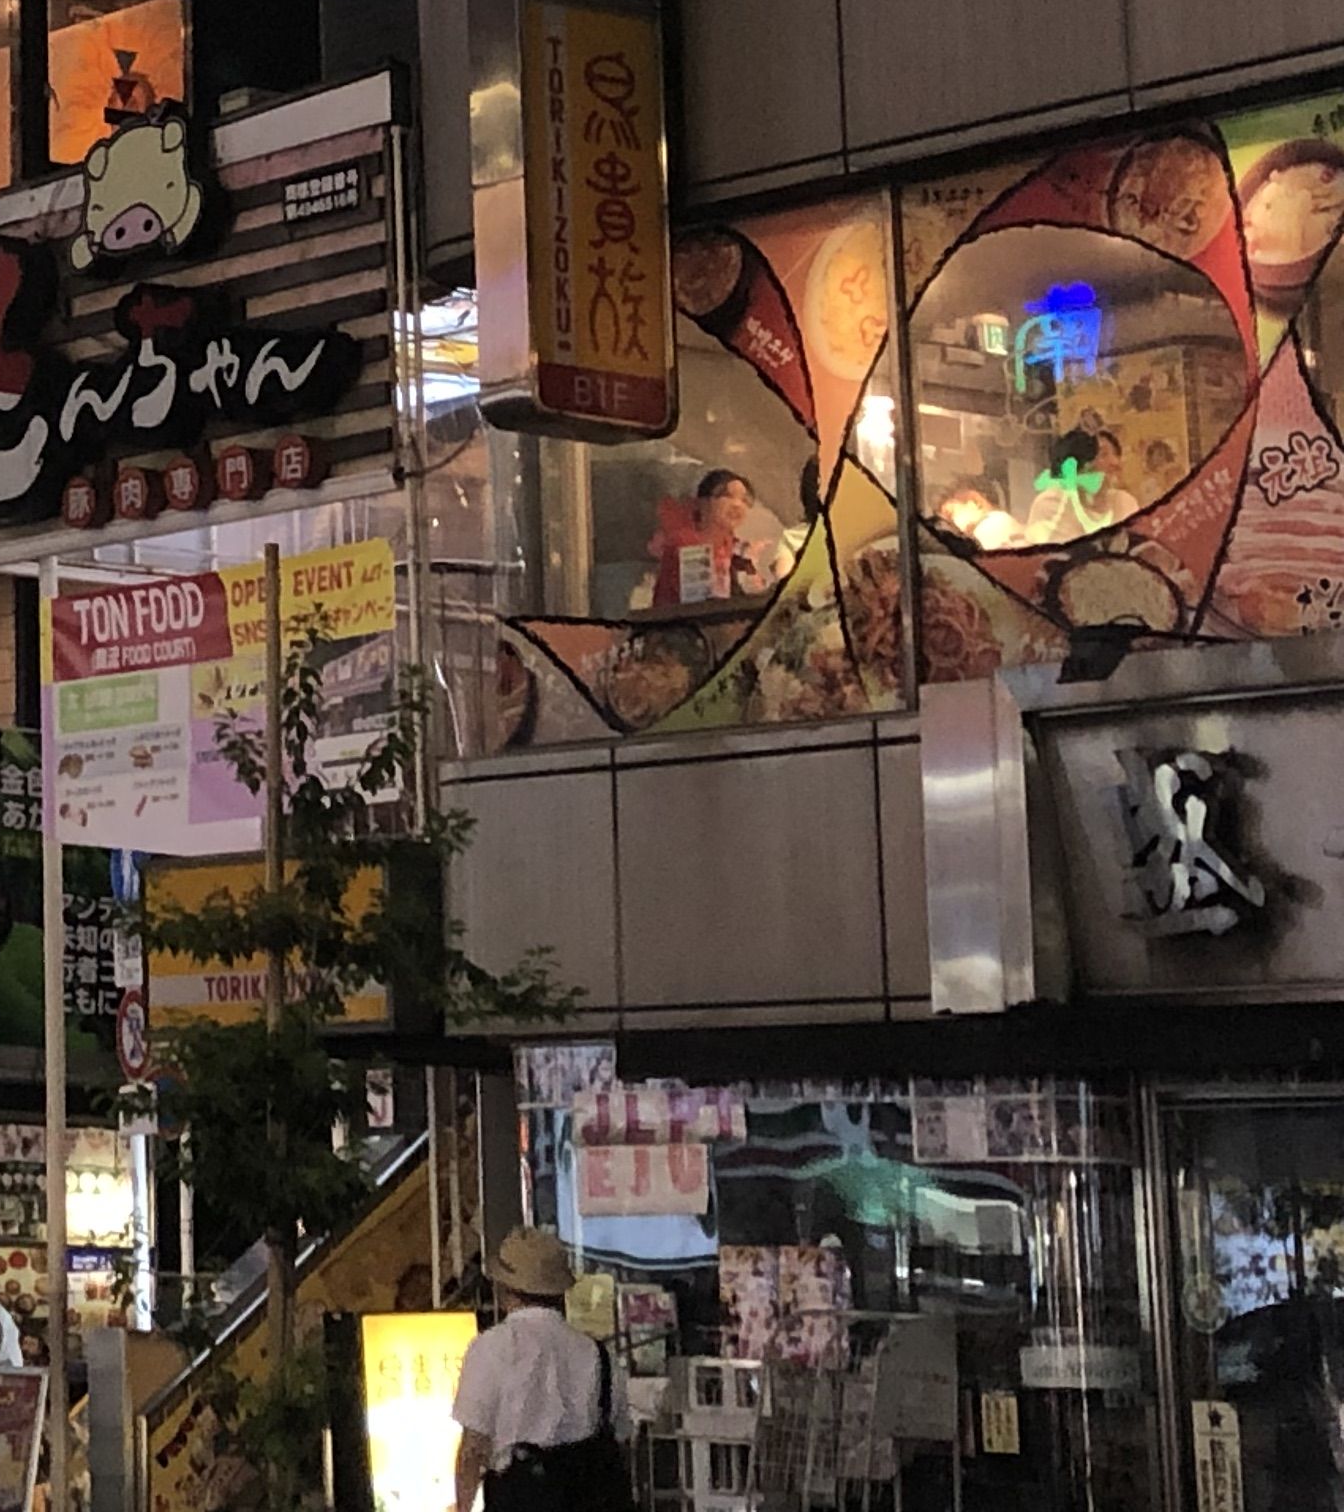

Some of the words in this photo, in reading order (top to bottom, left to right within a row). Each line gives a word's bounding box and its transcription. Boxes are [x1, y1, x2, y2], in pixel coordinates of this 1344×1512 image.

[573, 374, 629, 415] B1F
[230, 578, 267, 608] OPE
[292, 559, 355, 597] EVENT
[72, 592, 129, 646] TON
[130, 581, 205, 637] FOOD
[586, 1146, 703, 1198] EJU
